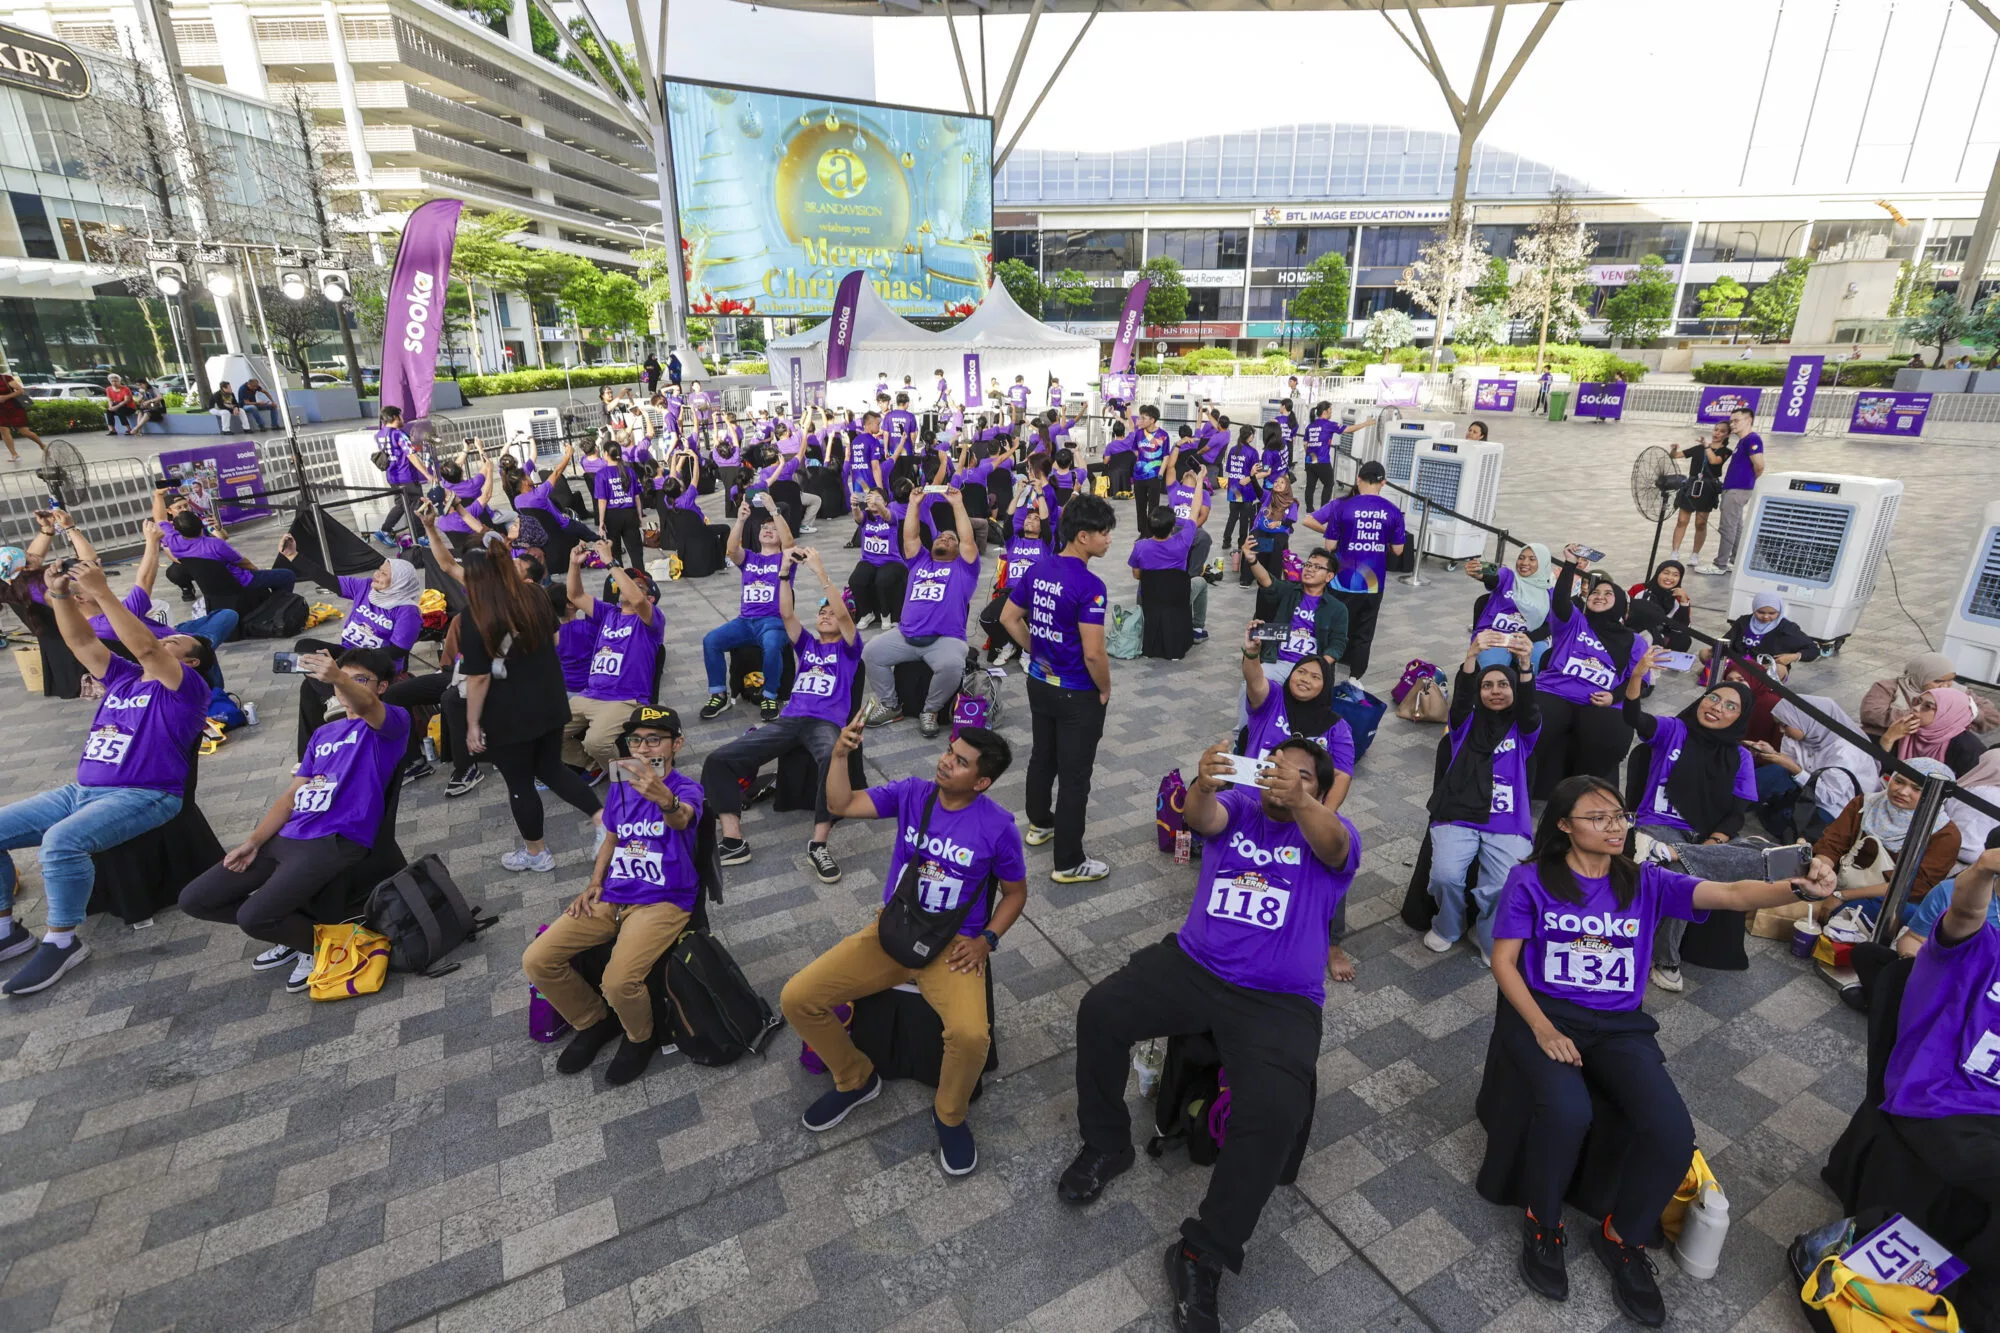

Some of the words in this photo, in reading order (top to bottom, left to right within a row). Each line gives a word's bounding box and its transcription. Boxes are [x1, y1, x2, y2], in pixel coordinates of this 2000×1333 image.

[1286, 212, 1307, 221] BTL
[1310, 211, 1347, 220] IMAGE
[1350, 210, 1416, 220] EDUCATION
[802, 236, 894, 277] Merry
[762, 266, 933, 301] Chrimas!
[403, 270, 434, 355] sooka
[837, 306, 851, 347] sooka
[1122, 310, 1137, 344] sooka
[968, 360, 976, 397] sooka
[1787, 364, 1813, 417] sooka
[1176, 490, 1195, 499] sook
[1354, 509, 1389, 520] sorak
[1356, 519, 1382, 530] bola
[1356, 530, 1379, 541] ikut
[866, 541, 887, 553] 002
[1013, 546, 1040, 556] sooka
[1348, 541, 1385, 552] sooka
[745, 562, 778, 574] sooka
[916, 567, 951, 578] sooka
[1011, 566, 1028, 577] 01
[746, 590, 772, 602] 139
[912, 586, 941, 599] 143
[1033, 578, 1064, 597] sorak
[1033, 592, 1056, 610] bola
[355, 604, 393, 631] sooka
[1033, 609, 1053, 626] ikut
[1294, 606, 1315, 622] ook
[1029, 623, 1063, 643] sooka
[1577, 631, 1606, 651] soo
[796, 677, 831, 694] 113
[296, 790, 330, 811] 137
[617, 818, 665, 839] sooka
[904, 826, 974, 867] sooka
[1229, 832, 1301, 866] sooka
[614, 856, 661, 883] 160
[920, 881, 952, 912] 11
[1213, 887, 1281, 926] 118
[1543, 911, 1641, 938] sooka
[1553, 951, 1629, 988] 134
[1865, 1230, 1920, 1280] 157
